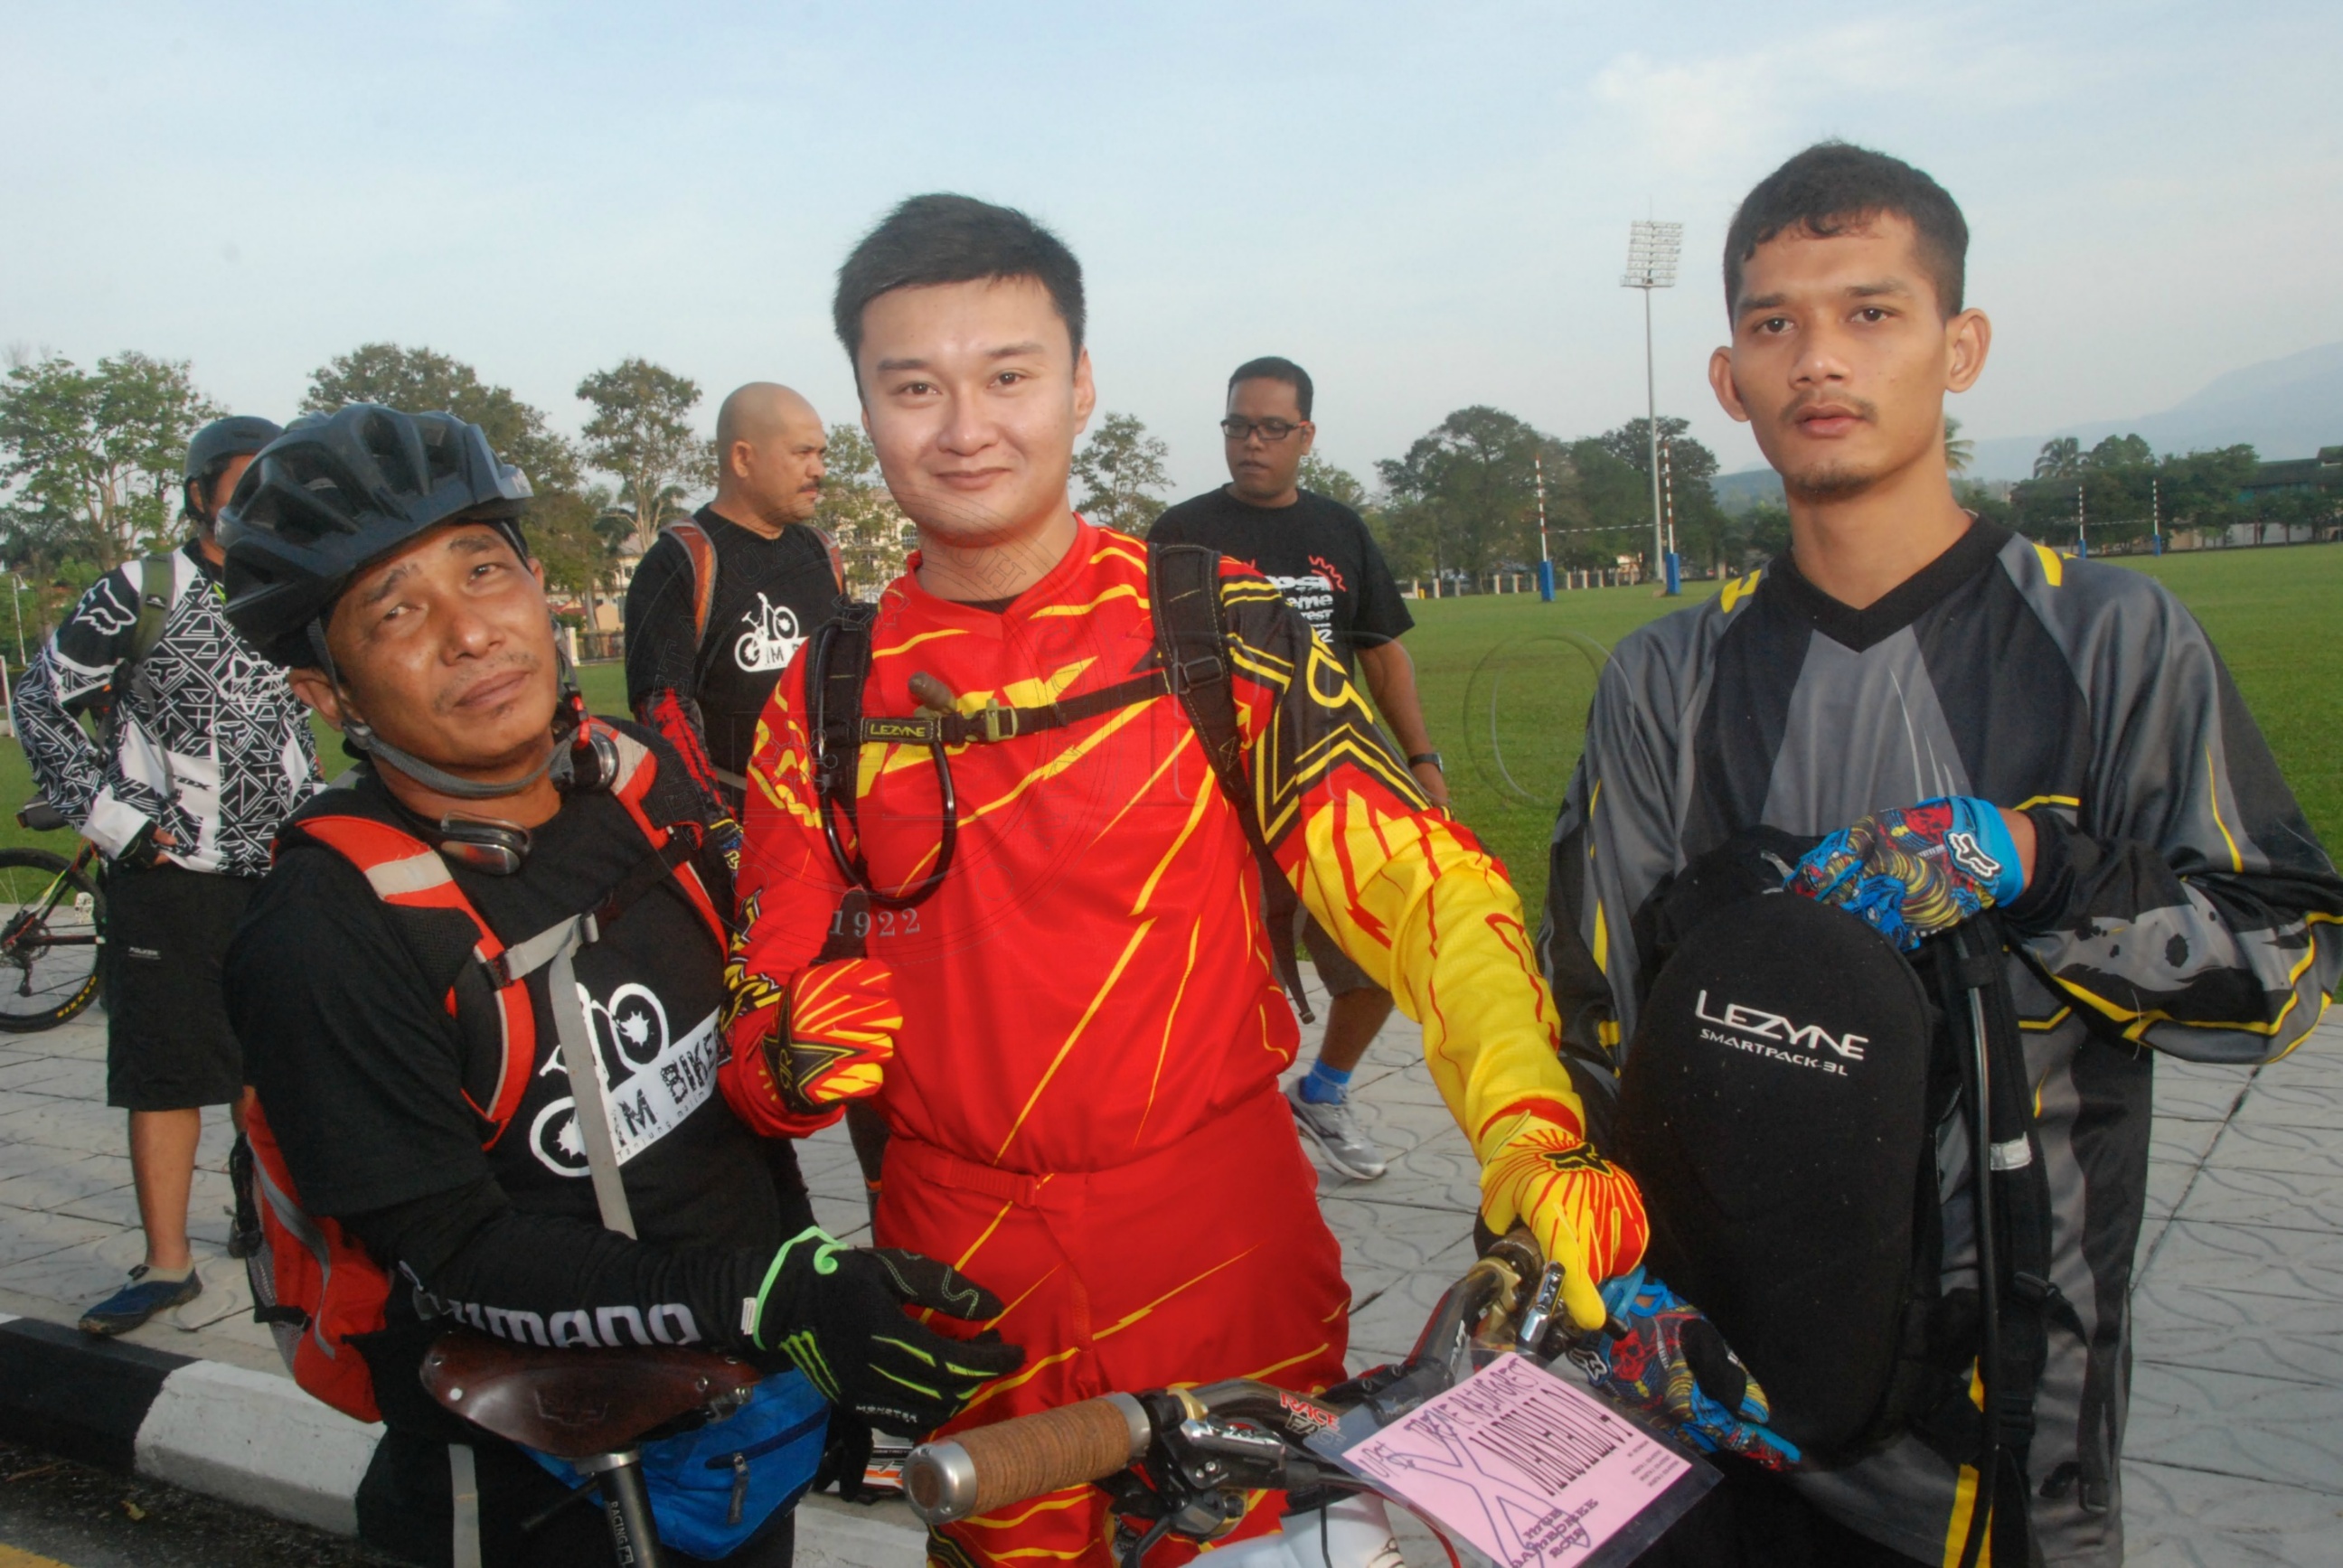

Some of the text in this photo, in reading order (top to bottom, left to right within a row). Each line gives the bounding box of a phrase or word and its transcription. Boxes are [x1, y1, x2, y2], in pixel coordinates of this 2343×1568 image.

[870, 723, 926, 737] LEZYNE
[1695, 989, 1869, 1062] LEZYNE
[1278, 1391, 1341, 1432] RACE
[1284, 1412, 1347, 1450] FACE
[1467, 1396, 1620, 1498] MARSHALL
[607, 1500, 628, 1547] RACING
